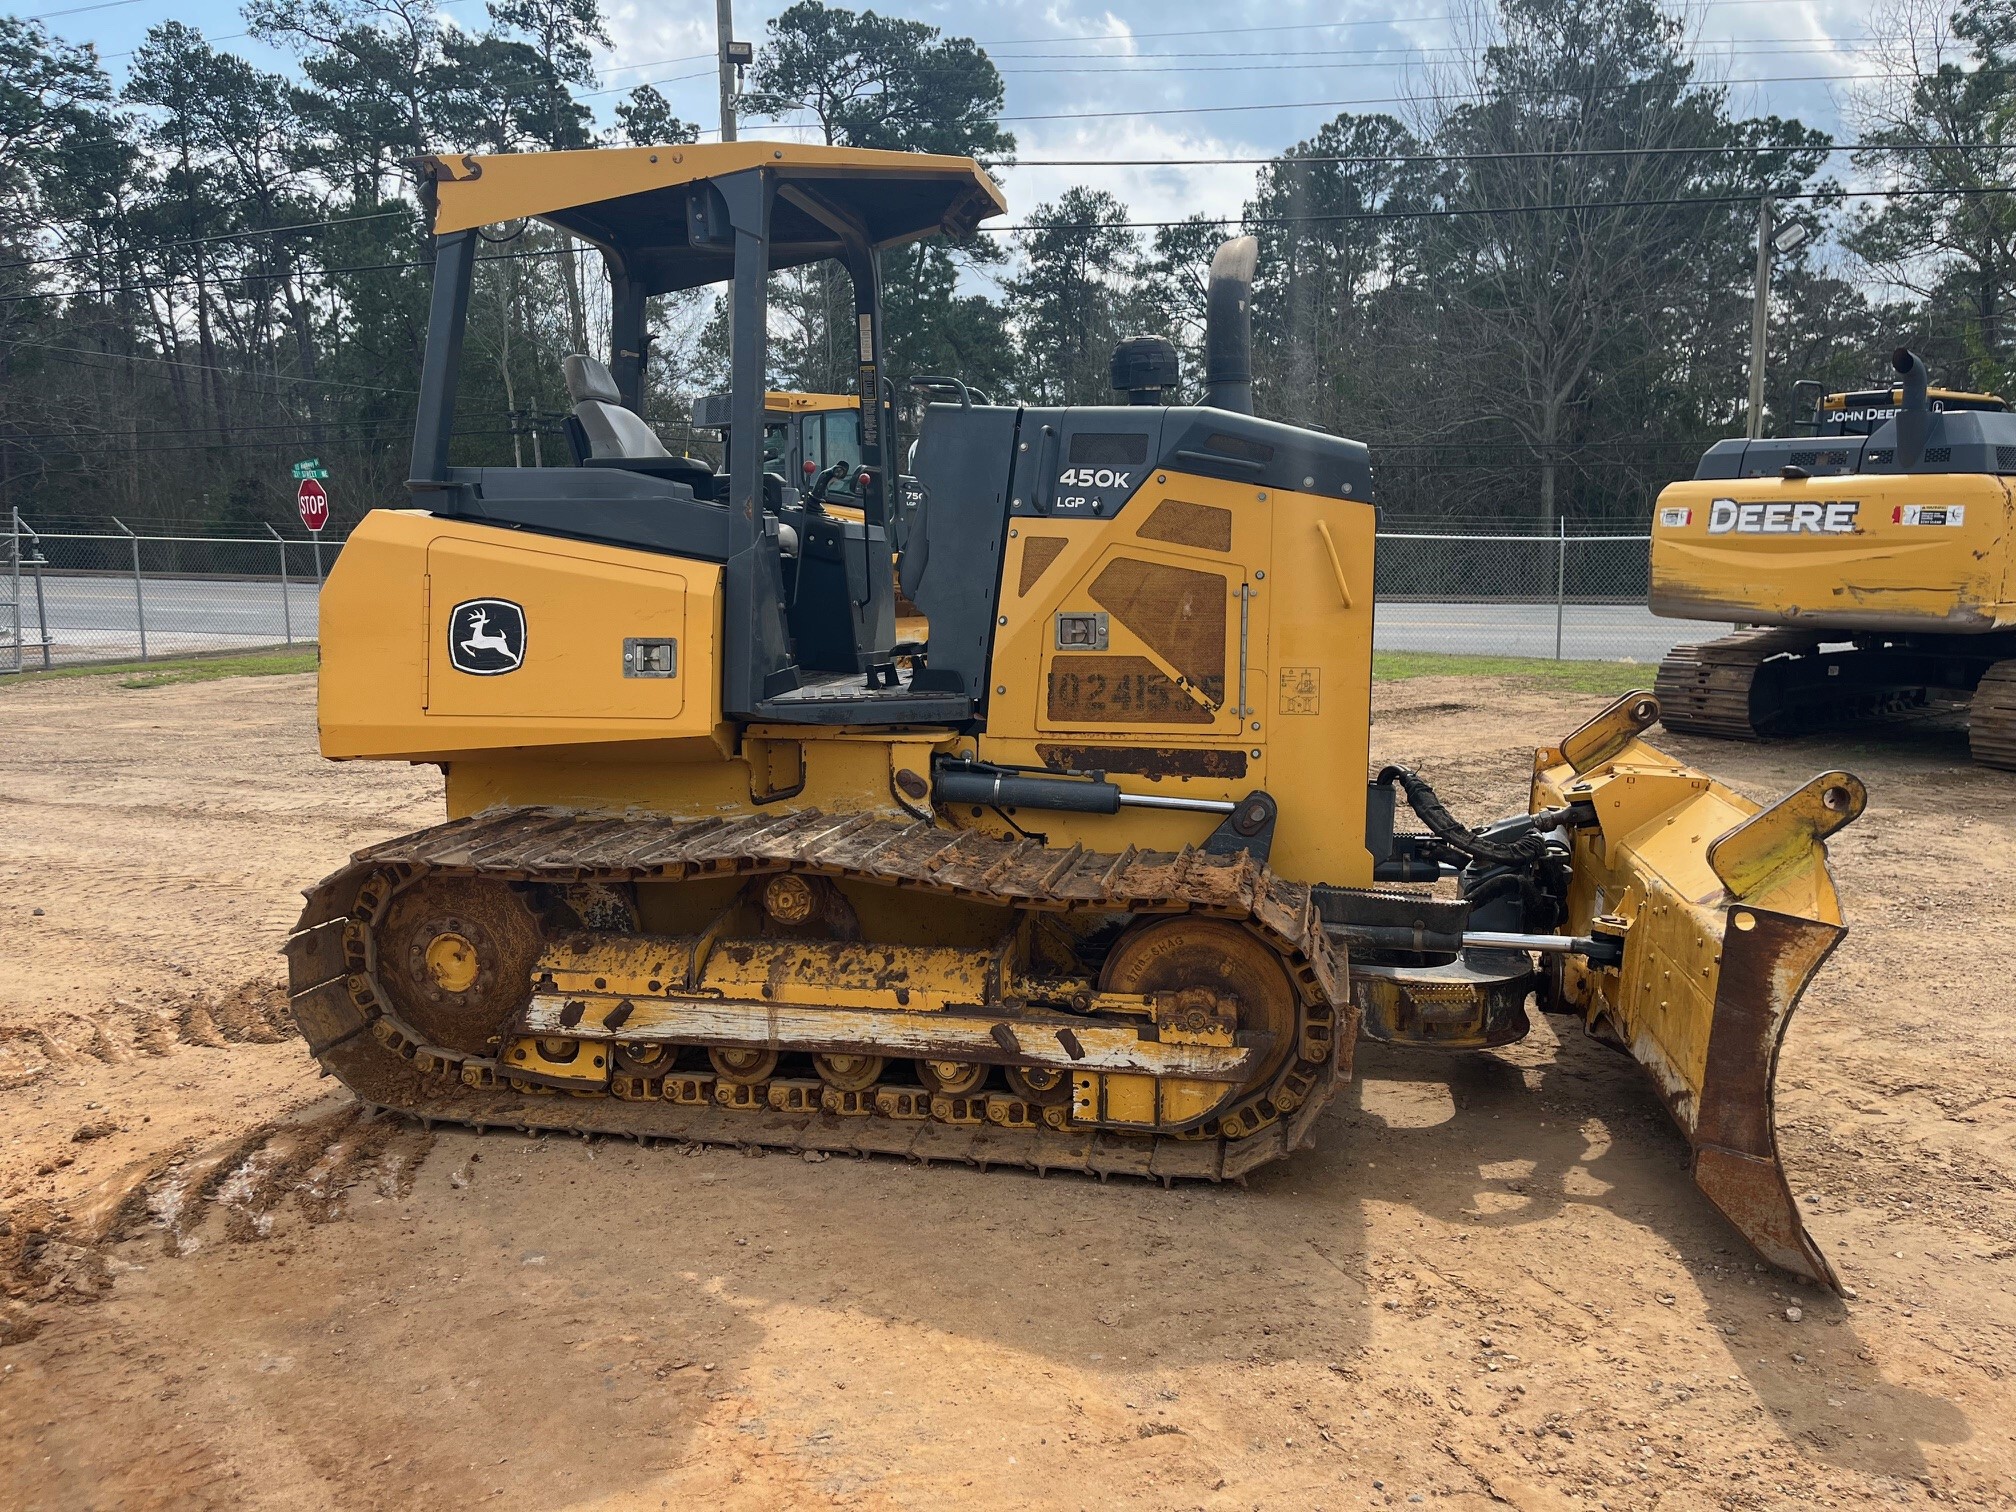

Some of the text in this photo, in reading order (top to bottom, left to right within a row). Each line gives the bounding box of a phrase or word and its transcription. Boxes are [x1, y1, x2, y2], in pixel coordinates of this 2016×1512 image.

[1827, 411, 1864, 423] JOHN
[1059, 468, 1130, 488] 450K
[300, 495, 325, 515] STOP
[1057, 496, 1086, 508] LGP
[1709, 499, 1858, 535] DEERE
